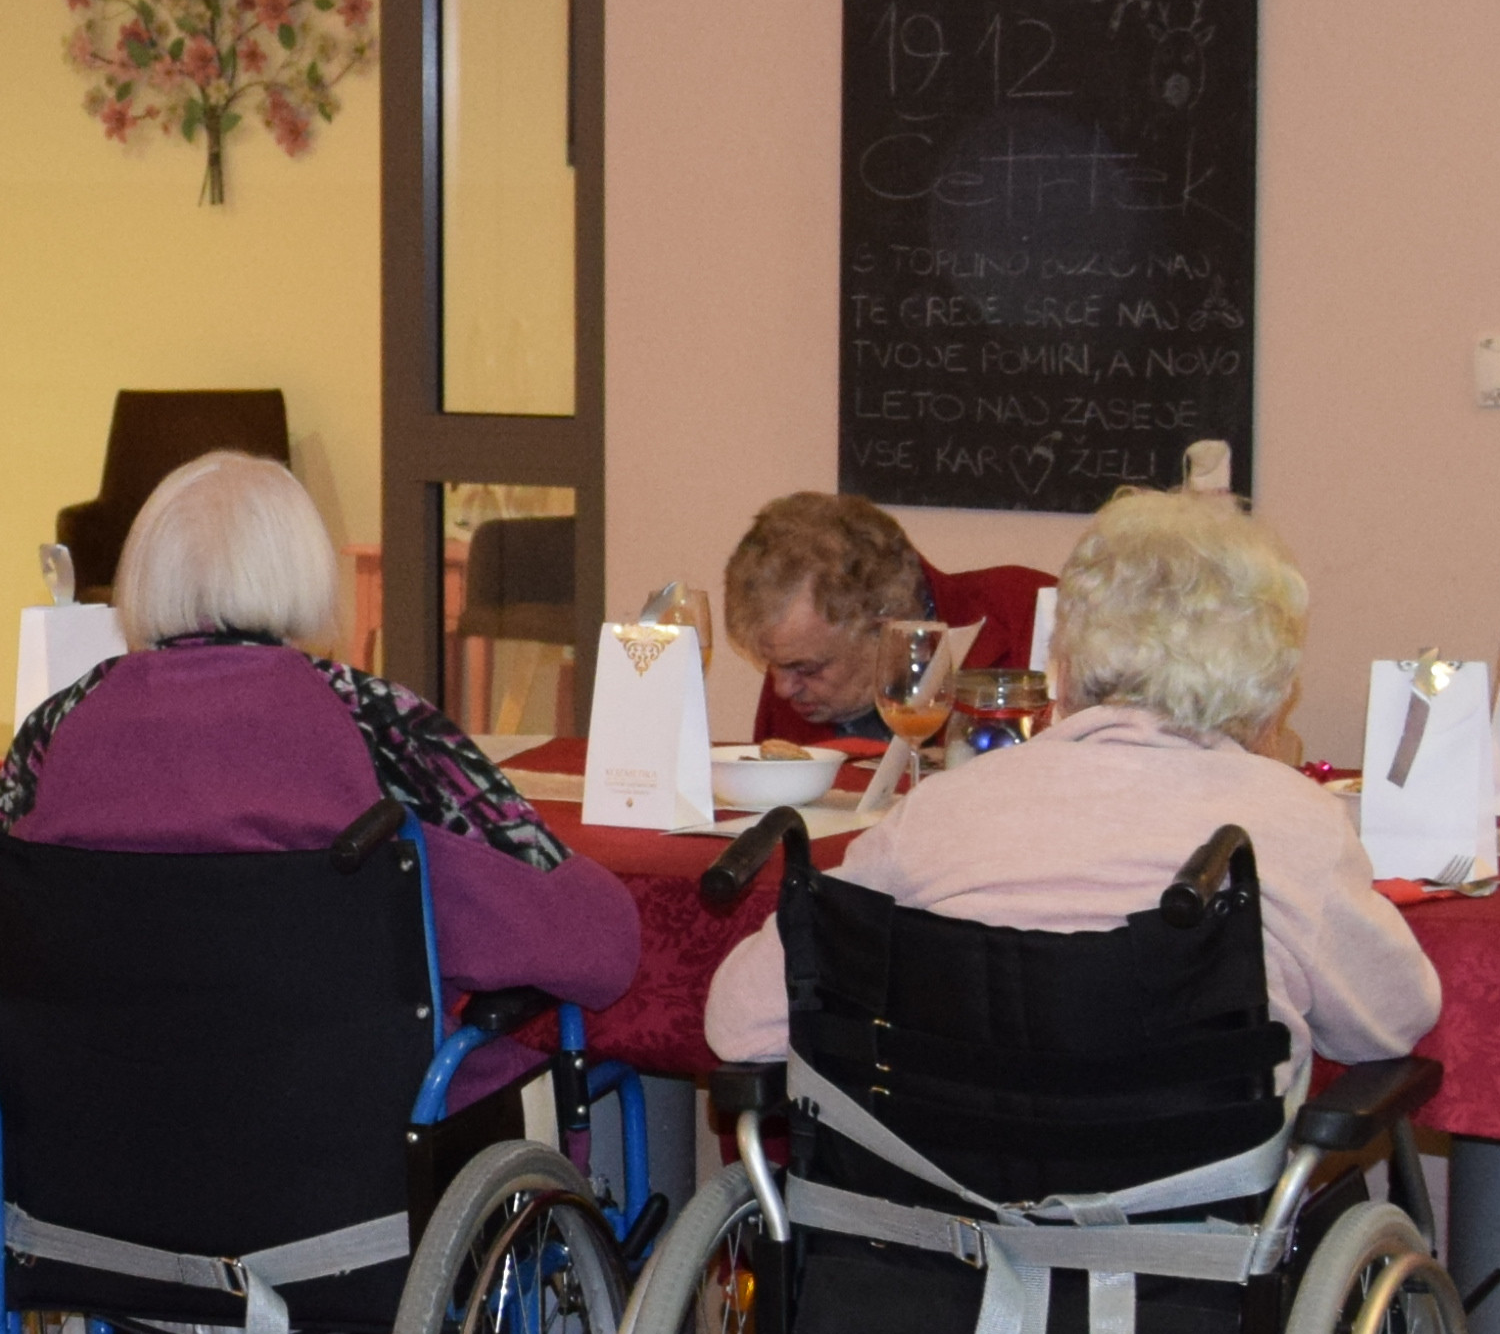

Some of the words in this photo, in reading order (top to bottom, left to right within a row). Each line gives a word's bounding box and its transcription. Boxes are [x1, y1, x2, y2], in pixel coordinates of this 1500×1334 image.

[974, 12, 1074, 106] 12
[850, 295, 888, 329] TE
[1023, 294, 1102, 329] SRCE
[1118, 300, 1180, 330] NAJ
[851, 340, 967, 373] TVOJE
[1108, 349, 1135, 378] A
[1146, 348, 1241, 378] NOVO
[854, 390, 967, 419] LETO
[977, 393, 1049, 426] NAJ
[1061, 397, 1198, 430] ZASEJE
[935, 442, 998, 478] KAR
[1069, 433, 1156, 480] ŽELI
